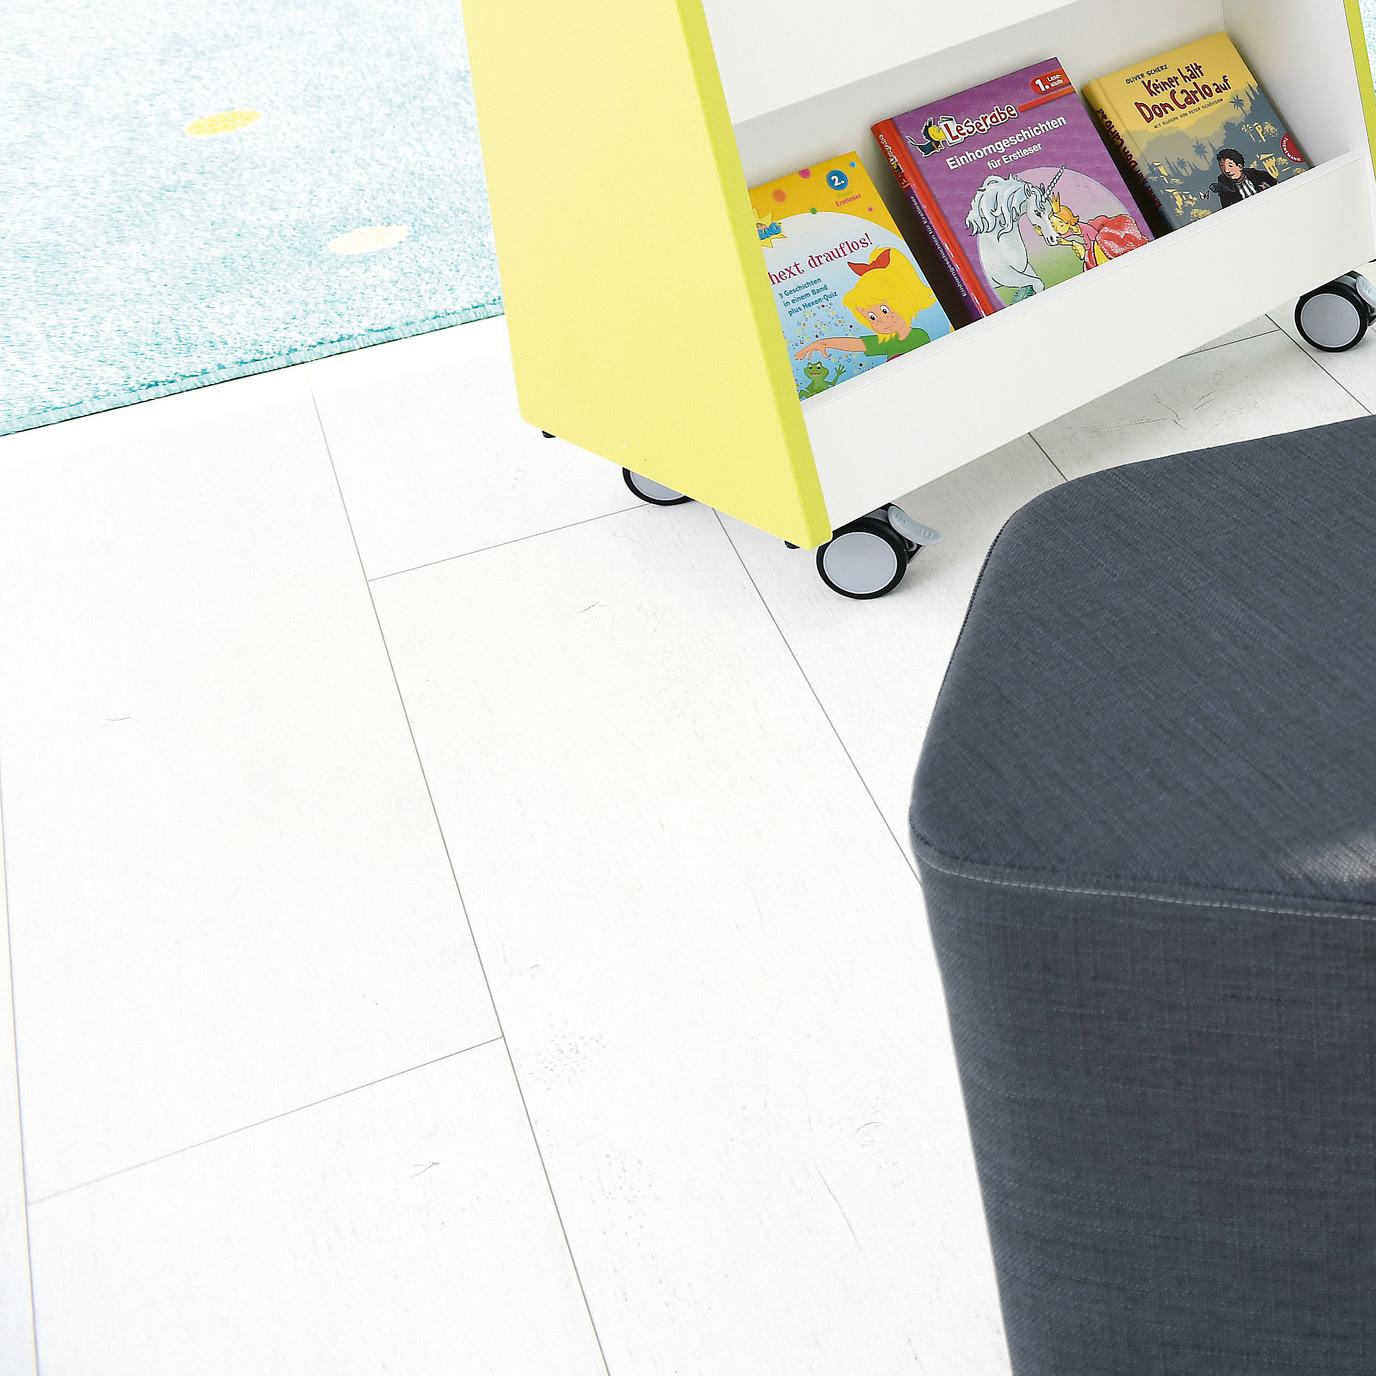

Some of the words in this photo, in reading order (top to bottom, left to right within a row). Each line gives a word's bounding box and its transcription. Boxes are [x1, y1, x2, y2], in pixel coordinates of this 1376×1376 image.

[1035, 78, 1050, 92] 1.
[1125, 73, 1145, 84] OLIVER
[1146, 64, 1168, 76] SCHERZ
[1141, 76, 1180, 97] Keiner
[1177, 63, 1204, 83] hält
[1134, 101, 1175, 124] Don
[1170, 82, 1214, 110] Carlo
[1212, 75, 1232, 94] auf
[943, 104, 1017, 142] Leserabe
[945, 116, 1068, 170] Einhorngeschichten
[987, 159, 1002, 170] für
[1001, 143, 1042, 164] Erstleser
[831, 175, 845, 187] 2.
[767, 261, 805, 286] hext
[807, 232, 873, 269] drauflos!
[778, 292, 784, 300] 3
[784, 277, 822, 297] Geschichten
[783, 299, 791, 307] in
[791, 293, 811, 304] einem
[812, 284, 829, 295] Band
[788, 305, 802, 316] plus
[802, 291, 838, 310] Hexen-Quiz
